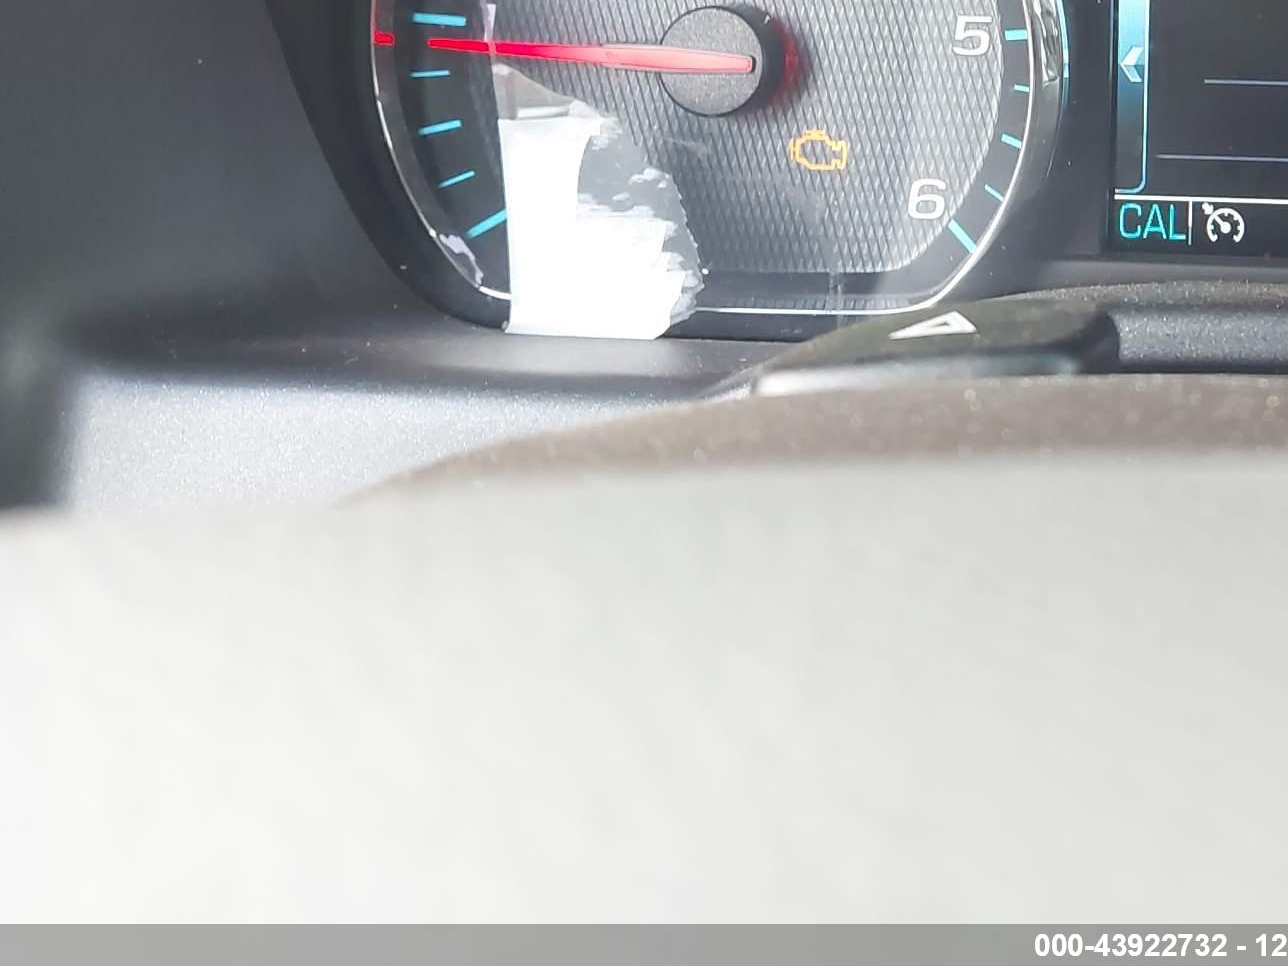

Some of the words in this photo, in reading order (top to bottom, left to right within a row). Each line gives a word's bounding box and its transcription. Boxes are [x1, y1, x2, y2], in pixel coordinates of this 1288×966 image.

[952, 15, 992, 57] 5
[906, 178, 948, 220] 6
[1119, 202, 1187, 240] CAL
